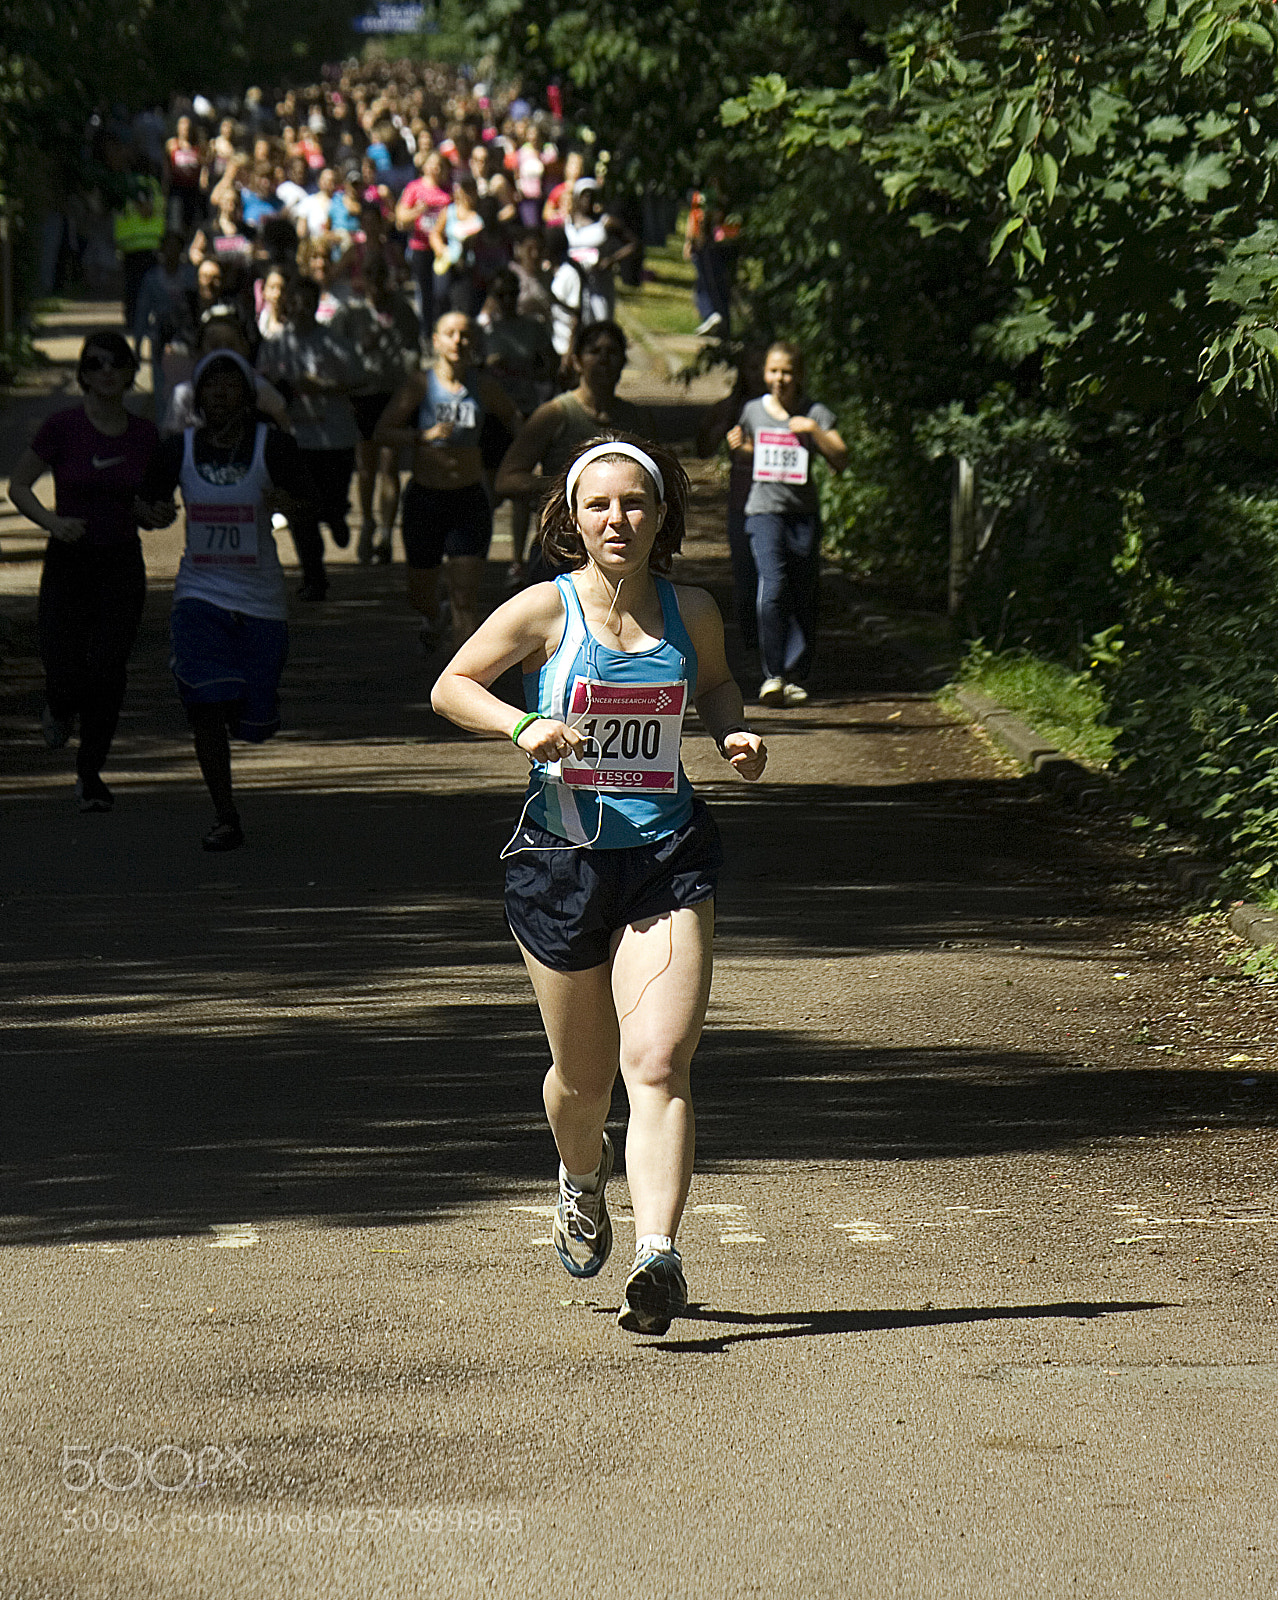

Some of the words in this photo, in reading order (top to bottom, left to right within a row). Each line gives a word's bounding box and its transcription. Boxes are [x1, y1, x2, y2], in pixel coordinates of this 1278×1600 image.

[206, 525, 240, 549] 770
[612, 697, 648, 705] RESEARCH
[583, 718, 661, 760] 1200
[596, 771, 643, 782] TESCO
